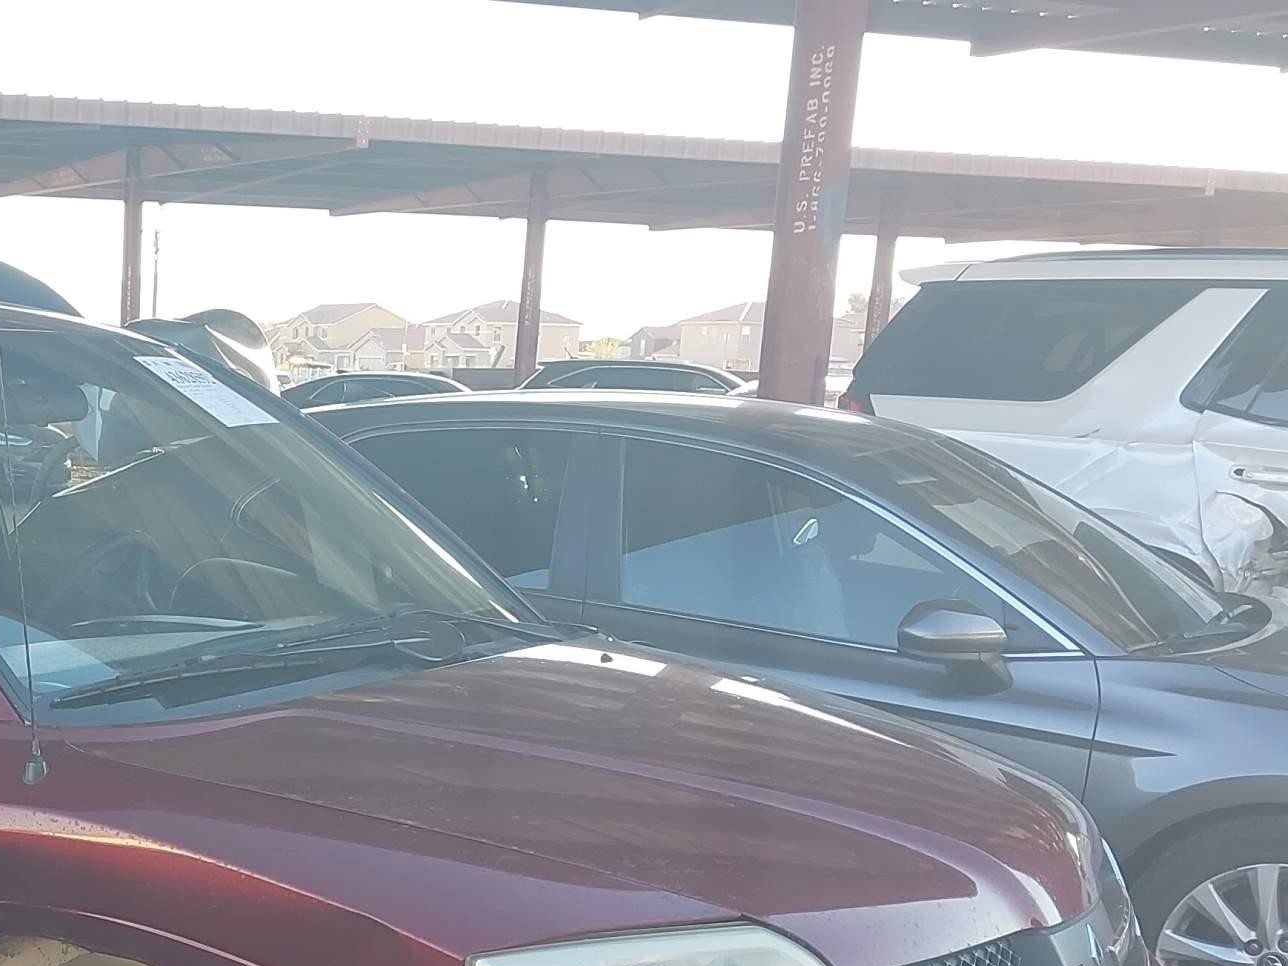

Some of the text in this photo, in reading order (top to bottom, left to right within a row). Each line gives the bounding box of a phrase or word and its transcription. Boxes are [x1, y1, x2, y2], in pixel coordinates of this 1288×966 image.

[793, 45, 824, 233] U.S. PREFAB INC.
